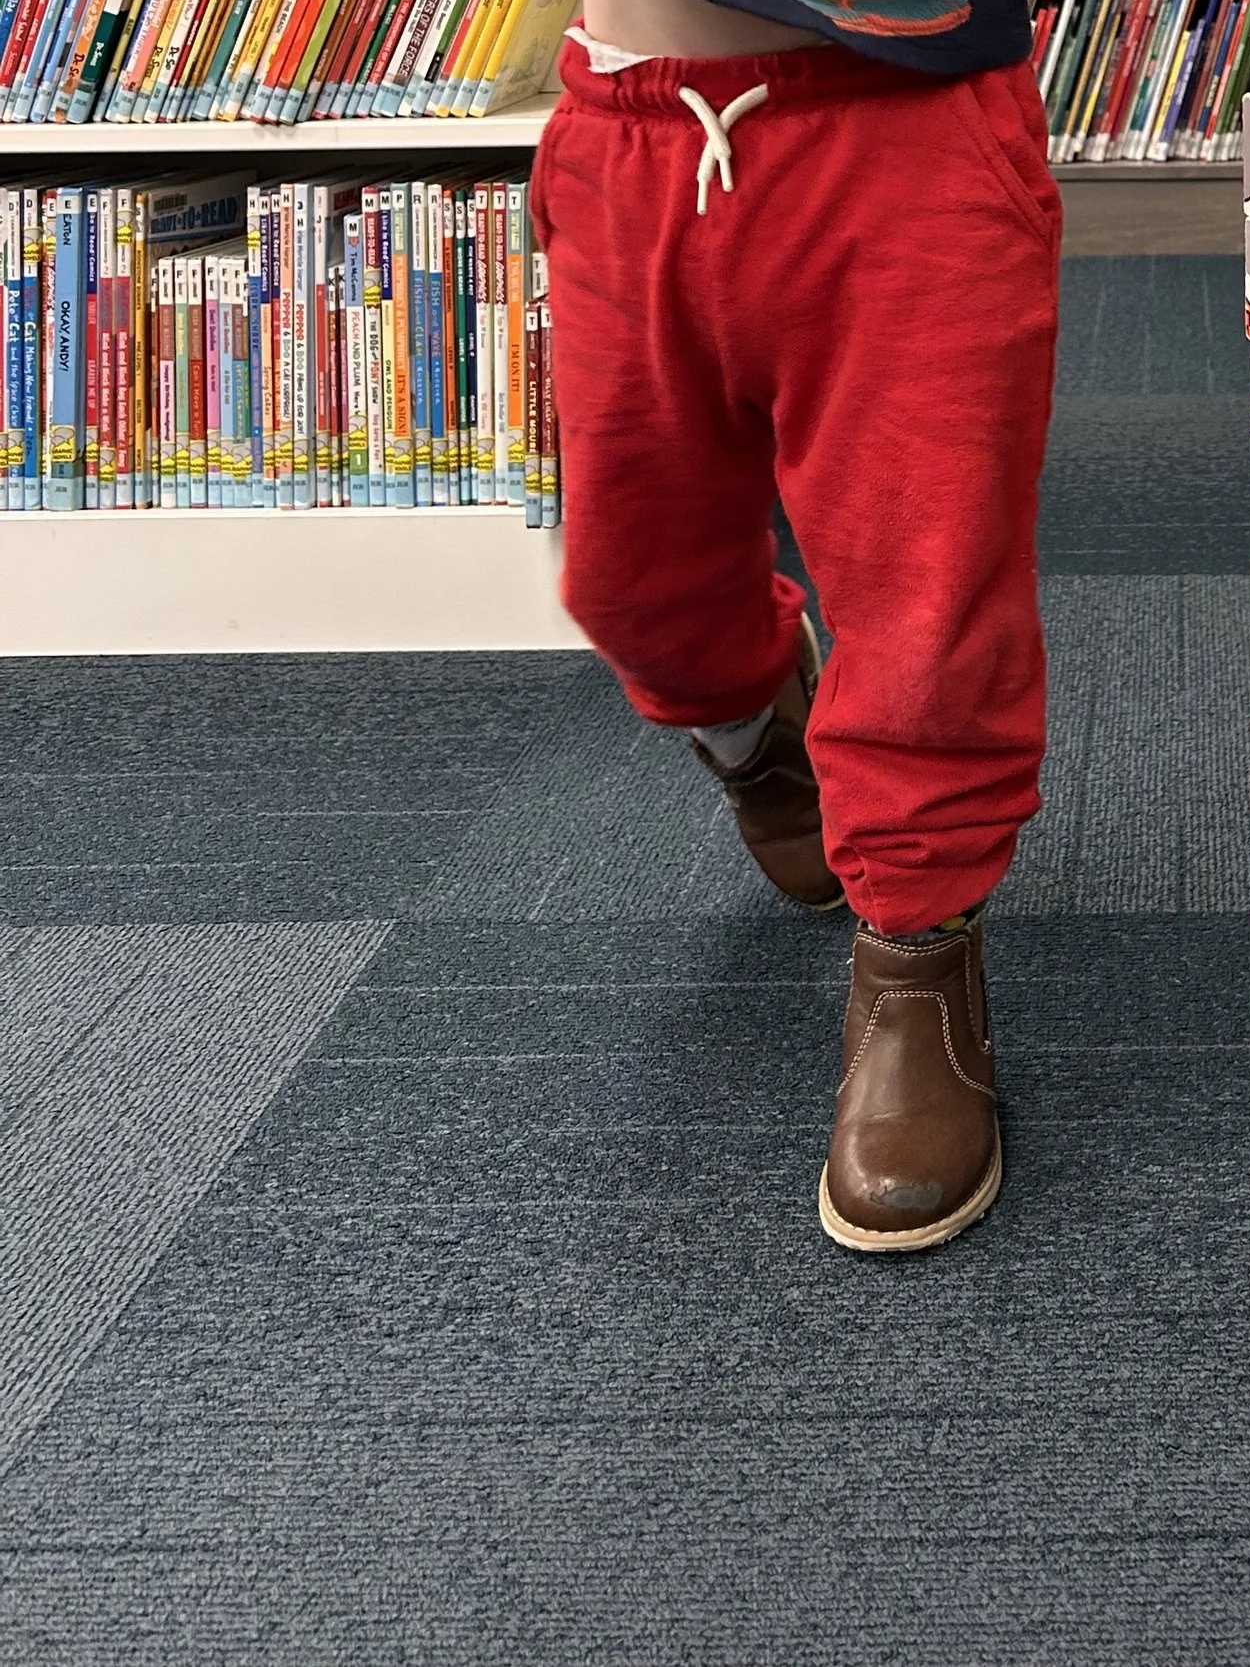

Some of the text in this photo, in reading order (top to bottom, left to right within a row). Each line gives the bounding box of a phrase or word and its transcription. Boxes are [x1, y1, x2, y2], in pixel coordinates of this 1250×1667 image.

[407, 23, 426, 46] THE
[396, 43, 418, 79] FORCE
[62, 213, 72, 246] EATON
[367, 217, 376, 265] READY-TO-READ
[477, 212, 487, 260] READY-TO-READ
[261, 266, 269, 292] Comics
[272, 260, 280, 286] Comics
[350, 252, 358, 302] Tim McCanna
[382, 263, 390, 289] Comics
[494, 213, 505, 303] READY-TO-READ GRAPHICS
[58, 301, 71, 372] OKAY, ANDY!
[295, 303, 305, 341] PEPPER
[414, 277, 424, 357] FISH CLAM
[432, 280, 441, 357] FISH WAVE
[7, 289, 20, 402] Pete Cat Space
[282, 291, 291, 419] PEPPER SURPRISE!
[352, 310, 361, 387] PEACH AND PLUM
[369, 333, 380, 385] DOG PONY
[510, 343, 520, 393] I'M ON IT!
[24, 321, 37, 425] Cat Making New Friends
[262, 365, 273, 416] Spring Cakes
[385, 396, 393, 430] PENGUIN
[397, 374, 408, 434] IT'S SIGN!
[528, 380, 537, 417] LITTLE
